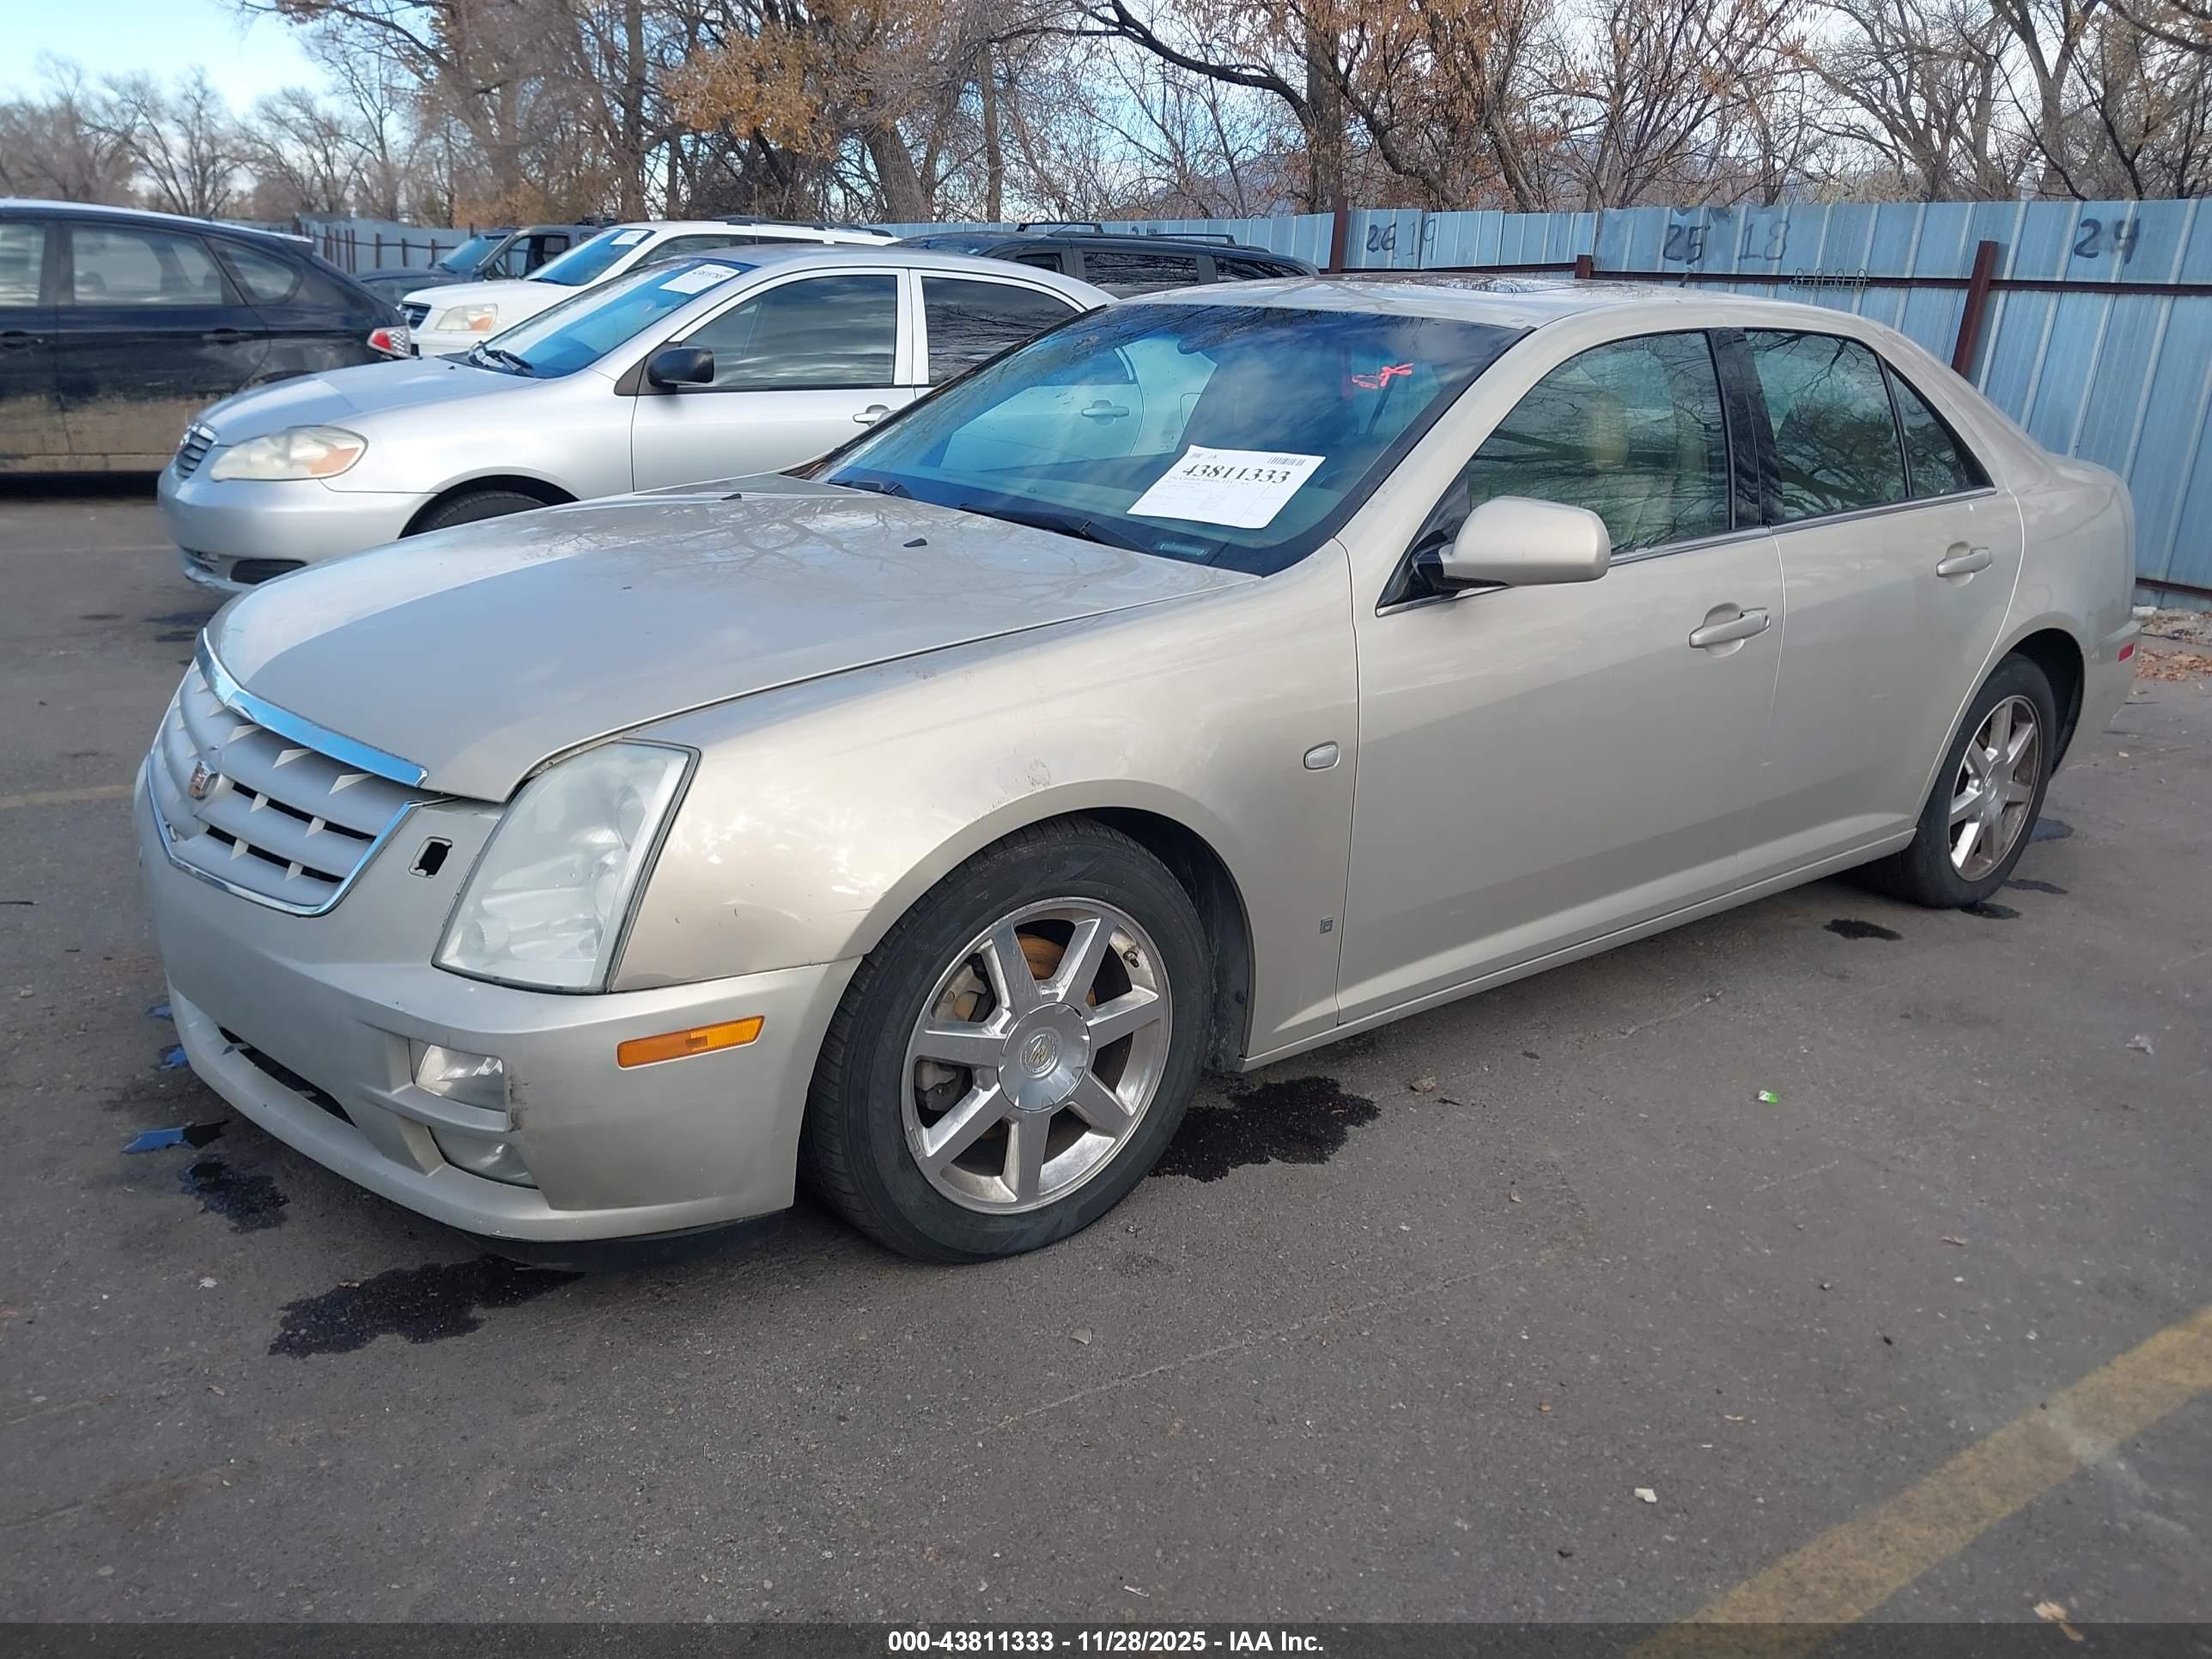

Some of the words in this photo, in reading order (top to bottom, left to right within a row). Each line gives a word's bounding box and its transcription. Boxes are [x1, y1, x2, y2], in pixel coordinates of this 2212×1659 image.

[1366, 222, 1397, 253] 26
[1662, 223, 1711, 264] 25
[1737, 219, 1791, 261] 18
[2073, 217, 2141, 264] 24
[1182, 463, 1291, 484] 43811333
